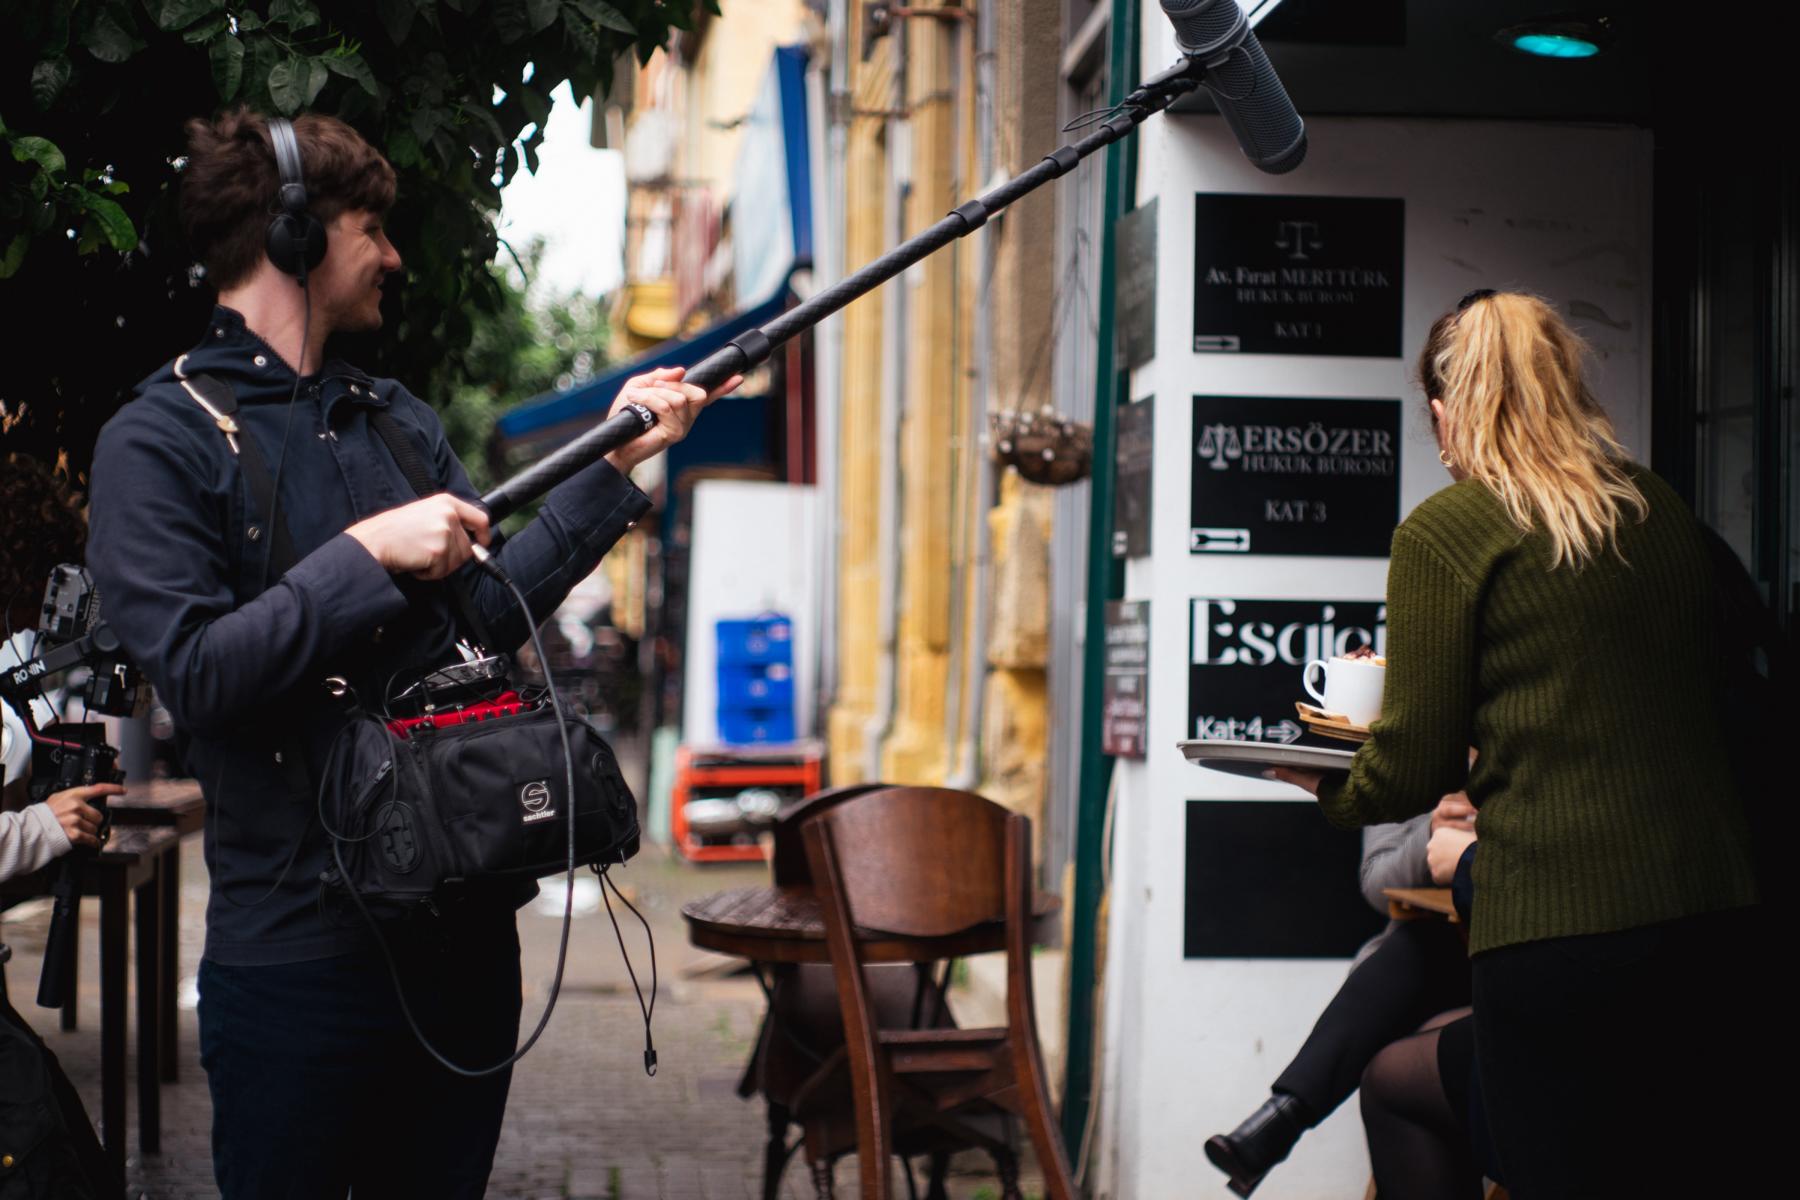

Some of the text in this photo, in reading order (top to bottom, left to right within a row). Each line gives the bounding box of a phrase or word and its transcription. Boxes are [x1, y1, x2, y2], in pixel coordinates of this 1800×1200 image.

[1205, 266, 1232, 284] Av.
[1236, 288, 1294, 304] HUKUK
[1274, 321, 1310, 337] KAT
[1242, 422, 1392, 455] ERSÖZER
[1241, 454, 1312, 474] HUKUK
[1264, 500, 1327, 522] KAT 3
[1197, 716, 1263, 741] Kat:4
